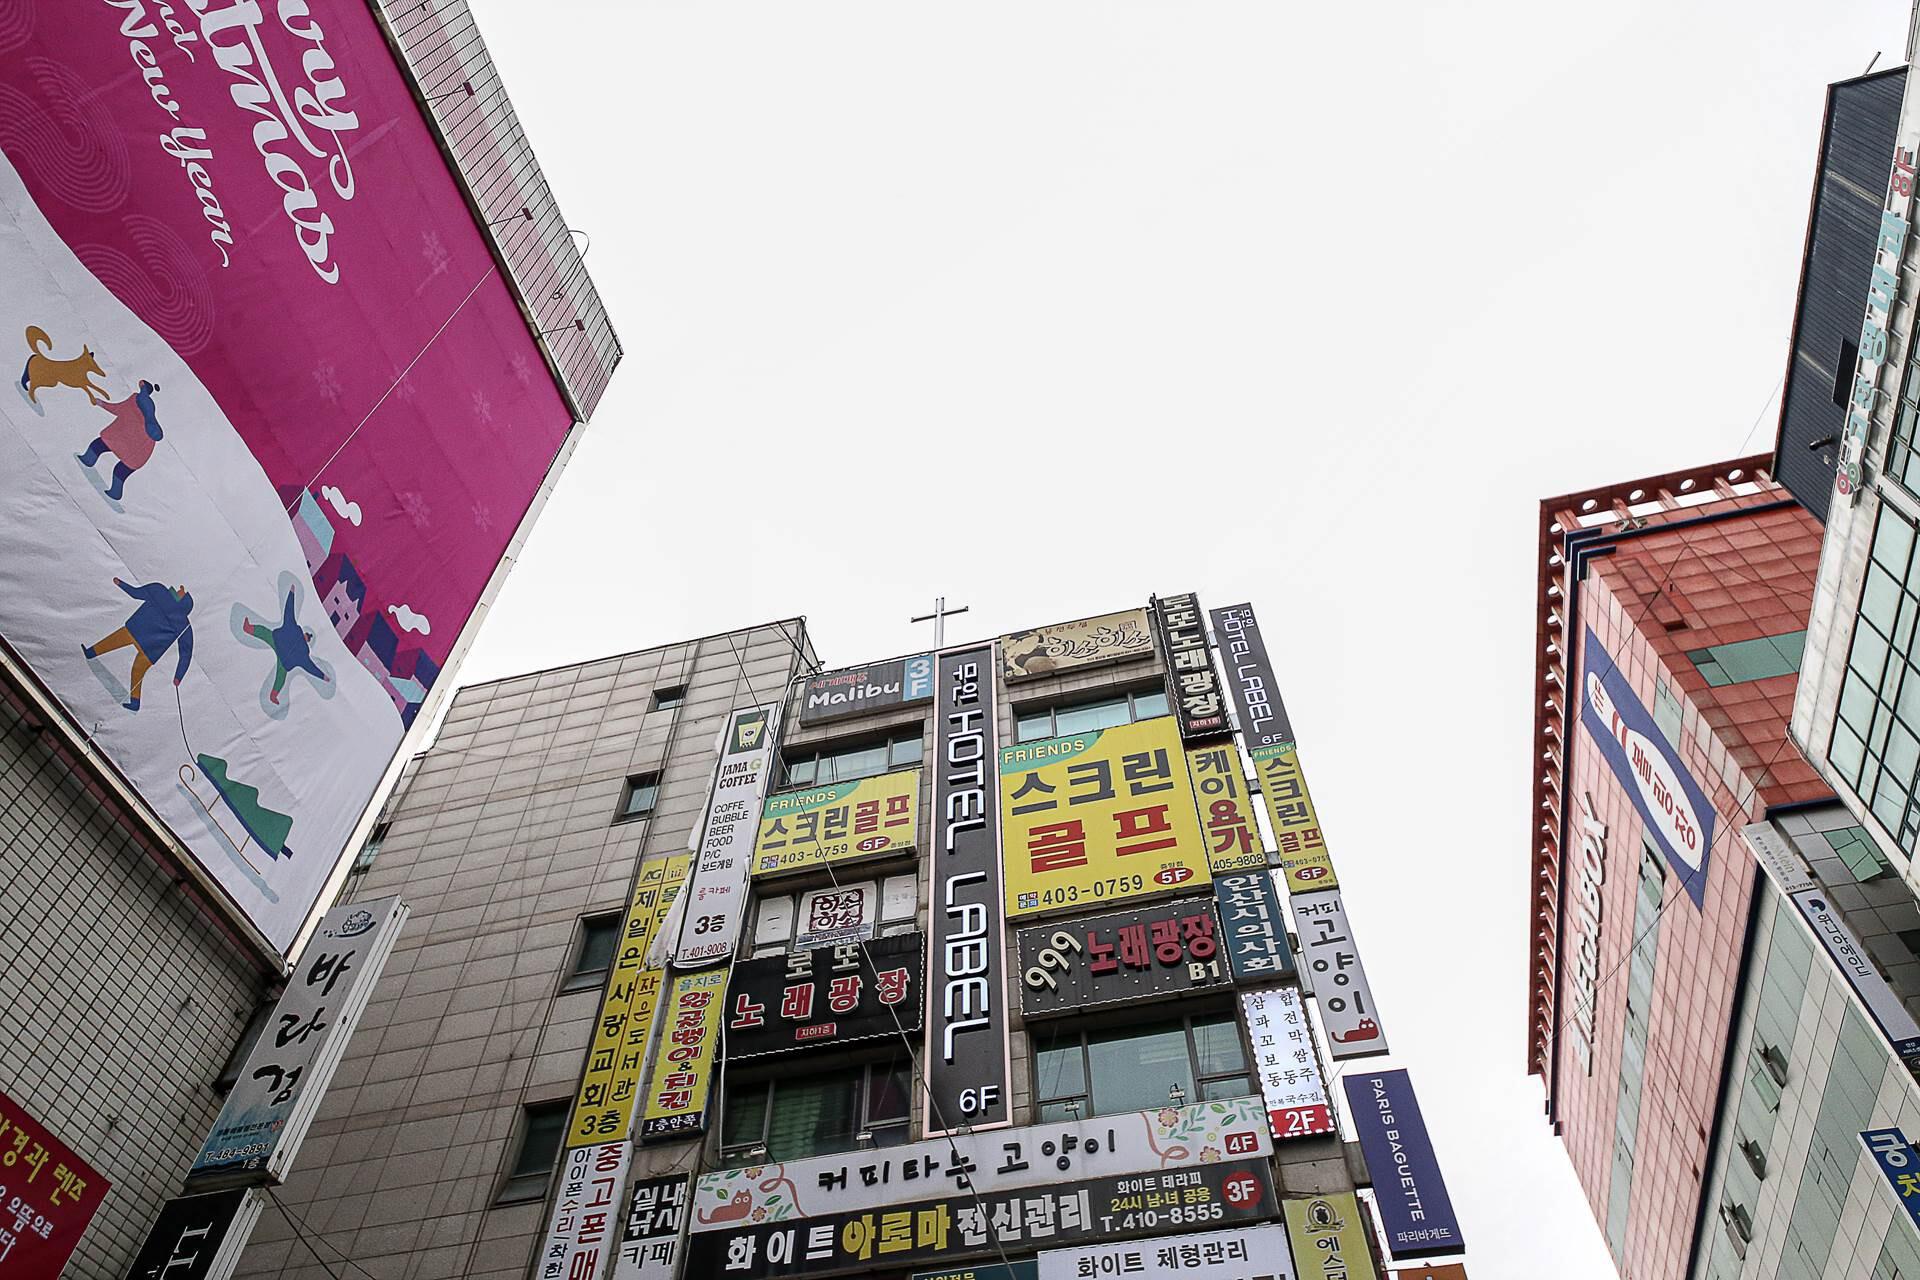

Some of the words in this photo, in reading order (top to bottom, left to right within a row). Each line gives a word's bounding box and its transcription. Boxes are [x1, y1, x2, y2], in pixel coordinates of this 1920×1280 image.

[106, 0, 181, 121] New
[160, 127, 230, 268] Year
[1221, 609, 1251, 664] HOTEL
[1237, 663, 1274, 734] LABEL
[809, 682, 900, 708] Malibu
[1003, 739, 1086, 764] FRIENDS
[1253, 745, 1291, 759] FRIENDS
[1262, 733, 1283, 745] 6F
[719, 773, 758, 789] COFFEE
[721, 762, 748, 778] JAMA
[947, 709, 985, 851] HOTEL
[1011, 748, 1175, 816] 스크린
[769, 790, 837, 812] FRIENDS
[1265, 757, 1311, 827] 스크린
[711, 811, 749, 825] BUBBLE
[714, 801, 745, 814] COFFE
[706, 836, 733, 848] FOOD
[709, 824, 735, 837] BEER
[1027, 804, 1178, 874] 골프
[1279, 828, 1324, 854] 골프
[703, 850, 721, 860] P/C
[780, 843, 848, 865] 403-0759
[861, 837, 887, 851] 5F
[700, 859, 734, 873] 보드게임
[1213, 853, 1264, 870] 405-9808
[1300, 868, 1324, 880] 5F
[1161, 869, 1187, 884] 5F
[1043, 875, 1143, 905] 403-0759
[1297, 901, 1340, 916] 커피
[694, 914, 726, 934] 3층
[1222, 874, 1283, 973] 안산시의사회
[682, 942, 727, 959] T.401-9008
[1087, 912, 1218, 973] 노래광장
[785, 943, 861, 980] 로또
[944, 870, 990, 1060] LABEL
[1025, 931, 1082, 991] 999
[1188, 960, 1221, 982] B1
[1311, 919, 1365, 1014] 고양이
[679, 974, 722, 991] 을지로
[730, 967, 910, 1030] 노래광장
[611, 976, 660, 1103] 작은도서관
[1267, 1067, 1315, 1087] 동동주
[959, 1085, 998, 1112] 6F
[580, 1110, 621, 1136] 3층
[1284, 1110, 1316, 1132] 2F
[997, 1129, 1116, 1175] 고양이
[1229, 1135, 1254, 1153] 4F
[1371, 1078, 1396, 1126] PARIS
[1386, 1130, 1426, 1222] BAGUETTE
[52, 1162, 90, 1206] 렌즈
[556, 1148, 592, 1233] 아이폰수리
[1117, 1176, 1157, 1194] 화이트
[1162, 1171, 1202, 1189] 테라피
[1226, 1179, 1255, 1202] 3F
[633, 1182, 687, 1213] 실내
[1111, 1194, 1142, 1212] 24시
[1184, 1186, 1211, 1203] 공용
[629, 1207, 683, 1237] 낚시
[1100, 1202, 1224, 1232] T.410-8555
[1397, 1227, 1452, 1243] 파리바게뜨
[0, 1236, 16, 1263] 다
[623, 1240, 676, 1270] 카페
[1077, 1249, 1144, 1279] 화이트
[1157, 1239, 1249, 1271] 체형관리
